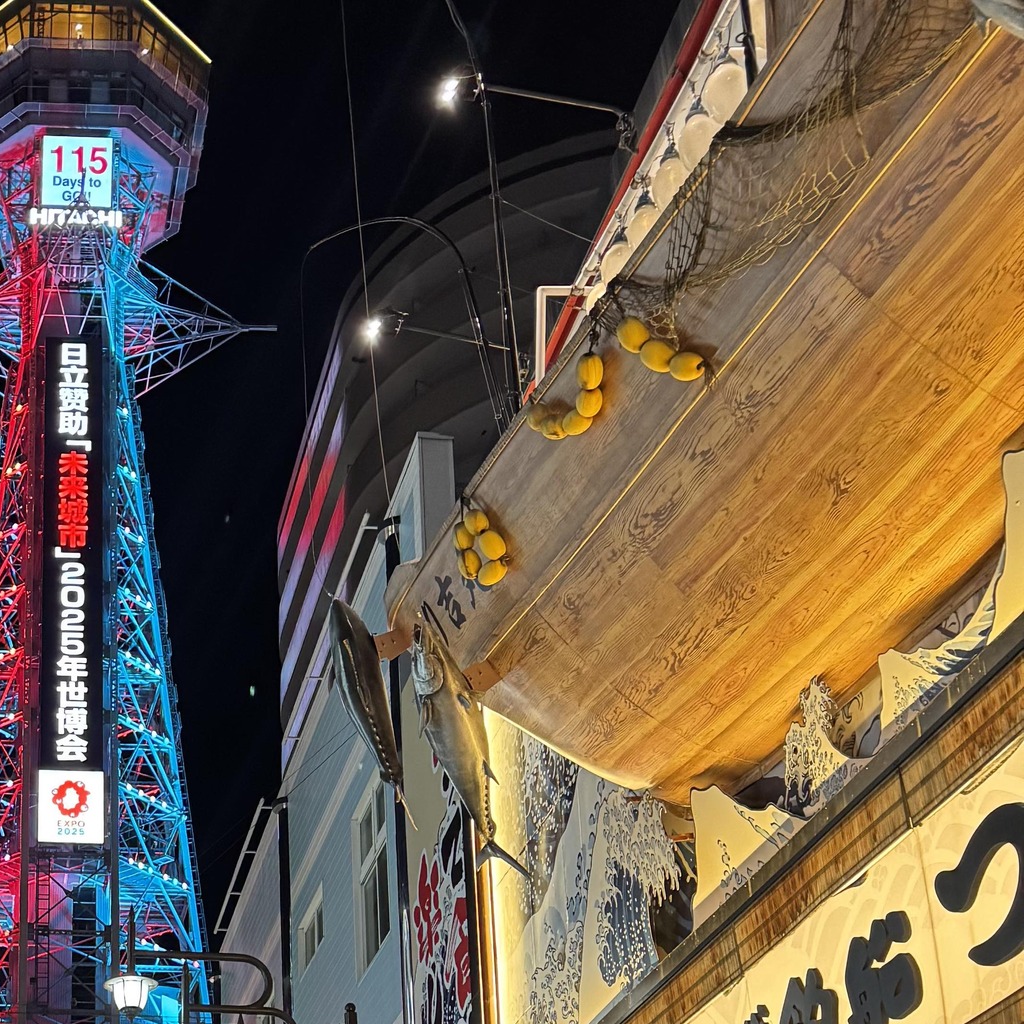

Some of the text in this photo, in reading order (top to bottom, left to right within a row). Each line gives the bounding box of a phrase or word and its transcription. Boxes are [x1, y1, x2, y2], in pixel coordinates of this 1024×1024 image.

[50, 145, 108, 175] 115
[52, 175, 102, 190] Days to
[29, 207, 123, 228] HITACHI
[57, 820, 85, 828] EXPO
[57, 828, 85, 836] 2025
